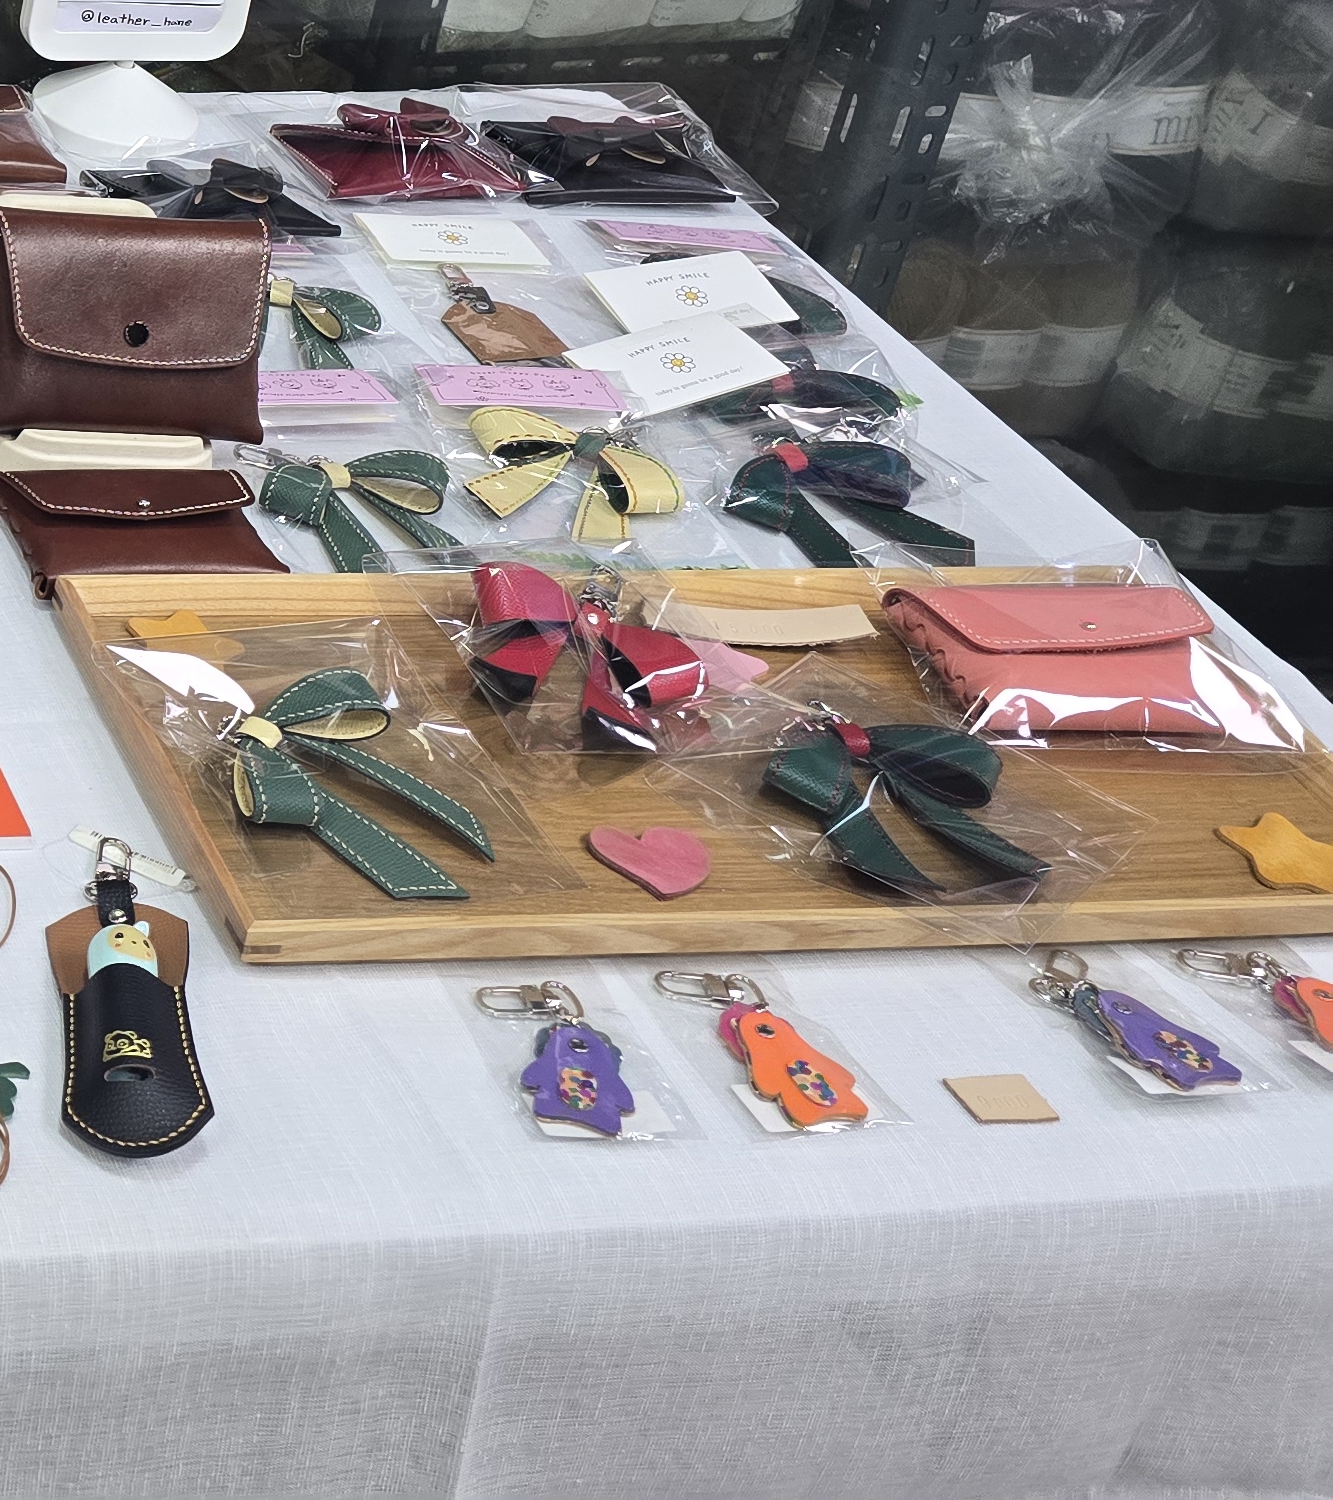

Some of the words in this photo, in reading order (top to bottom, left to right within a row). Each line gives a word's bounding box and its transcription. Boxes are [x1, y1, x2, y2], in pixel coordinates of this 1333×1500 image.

[646, 276, 673, 286] HAPPY
[628, 344, 655, 358] HAPPY
[659, 337, 691, 348] SMILE
